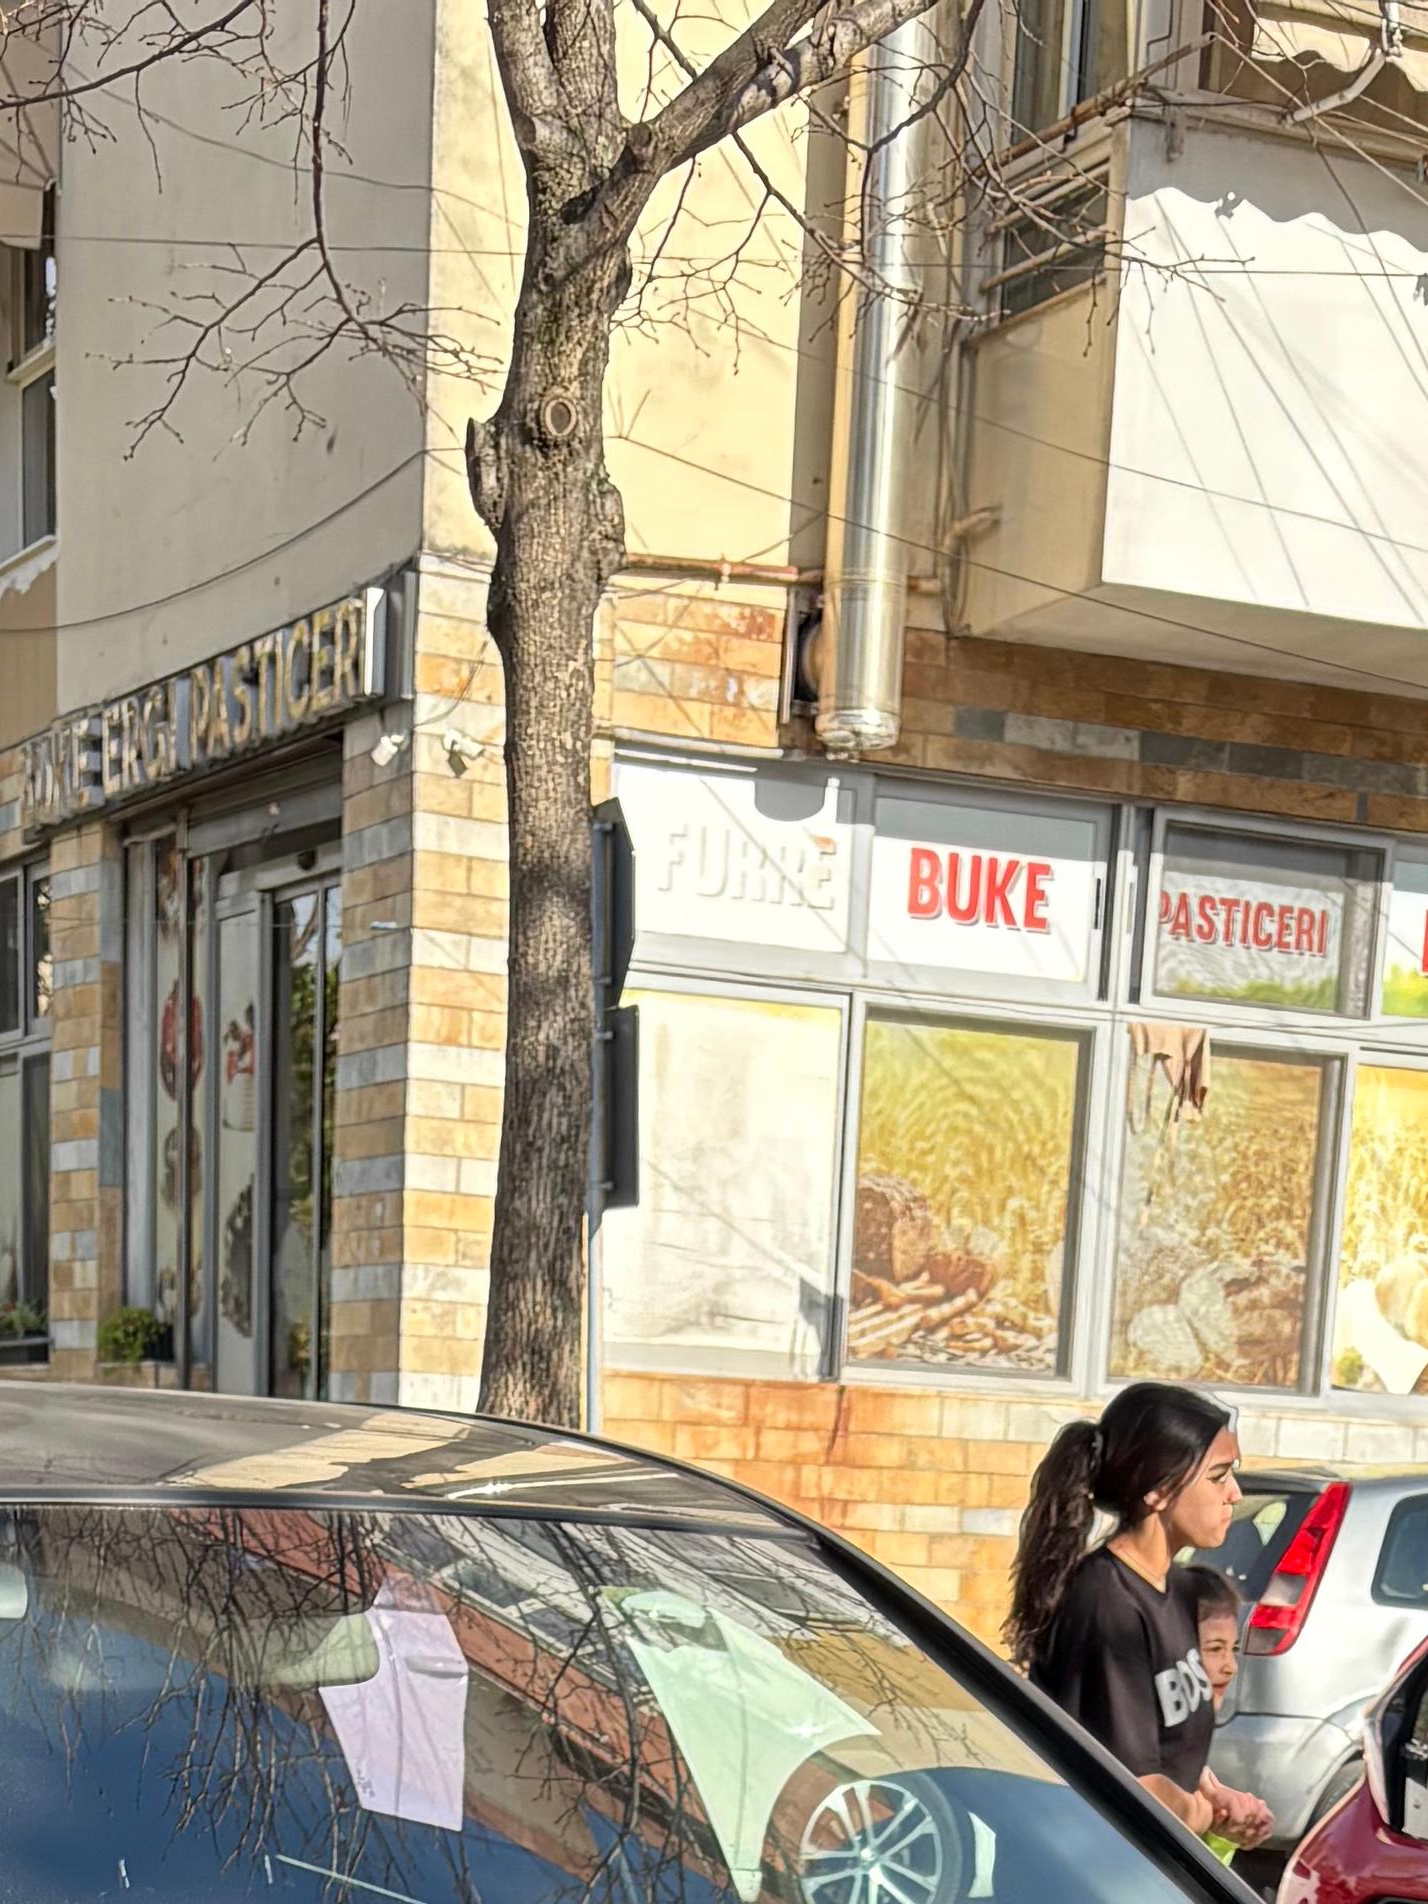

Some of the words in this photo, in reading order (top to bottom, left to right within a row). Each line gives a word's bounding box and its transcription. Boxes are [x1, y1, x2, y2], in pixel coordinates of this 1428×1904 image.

[101, 676, 178, 799] ERGI
[188, 586, 388, 765] PASTICERI
[906, 846, 1053, 934] BUKE
[1159, 891, 1329, 958] PASTICERI
